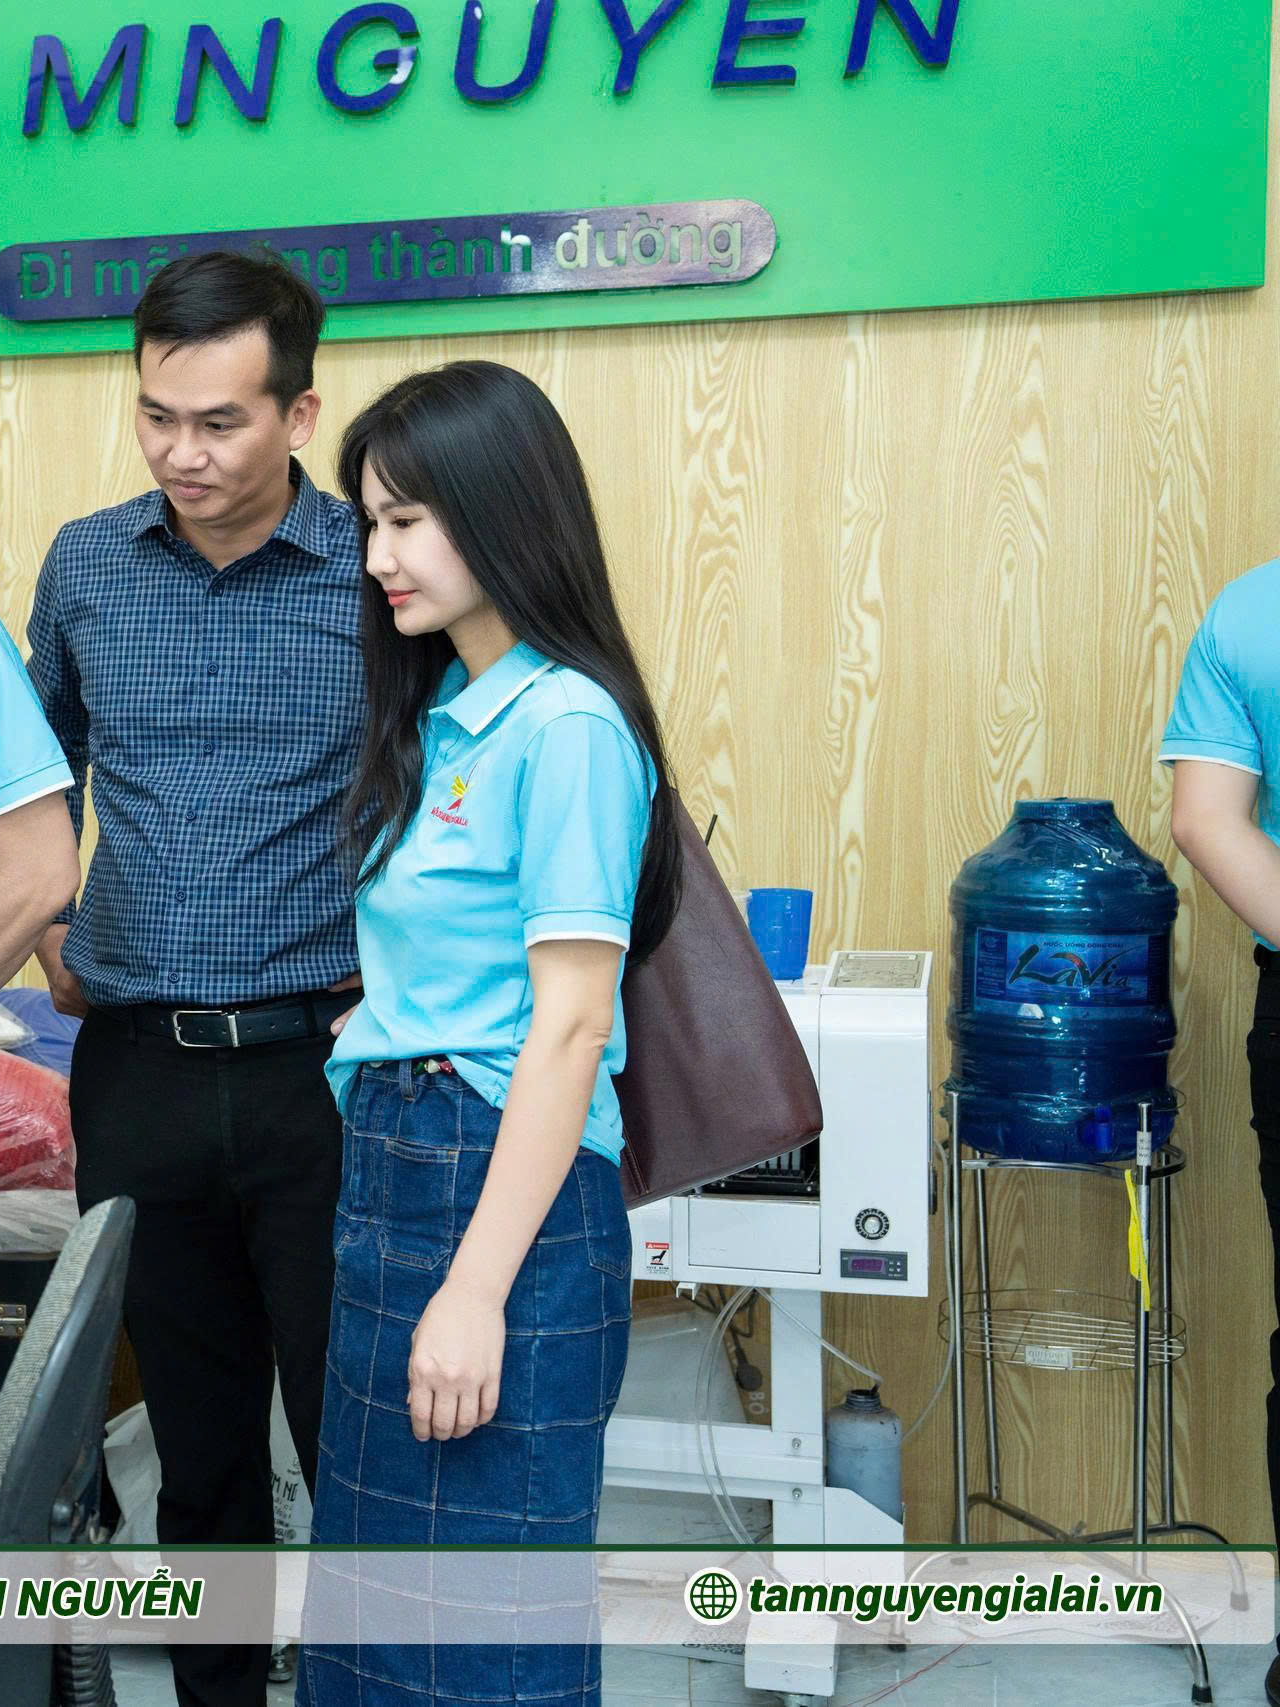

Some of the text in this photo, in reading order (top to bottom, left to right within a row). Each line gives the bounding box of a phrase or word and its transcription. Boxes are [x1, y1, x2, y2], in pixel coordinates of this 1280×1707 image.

[19, 250, 72, 300] Đi
[369, 226, 533, 281] thành
[554, 212, 743, 275] đường
